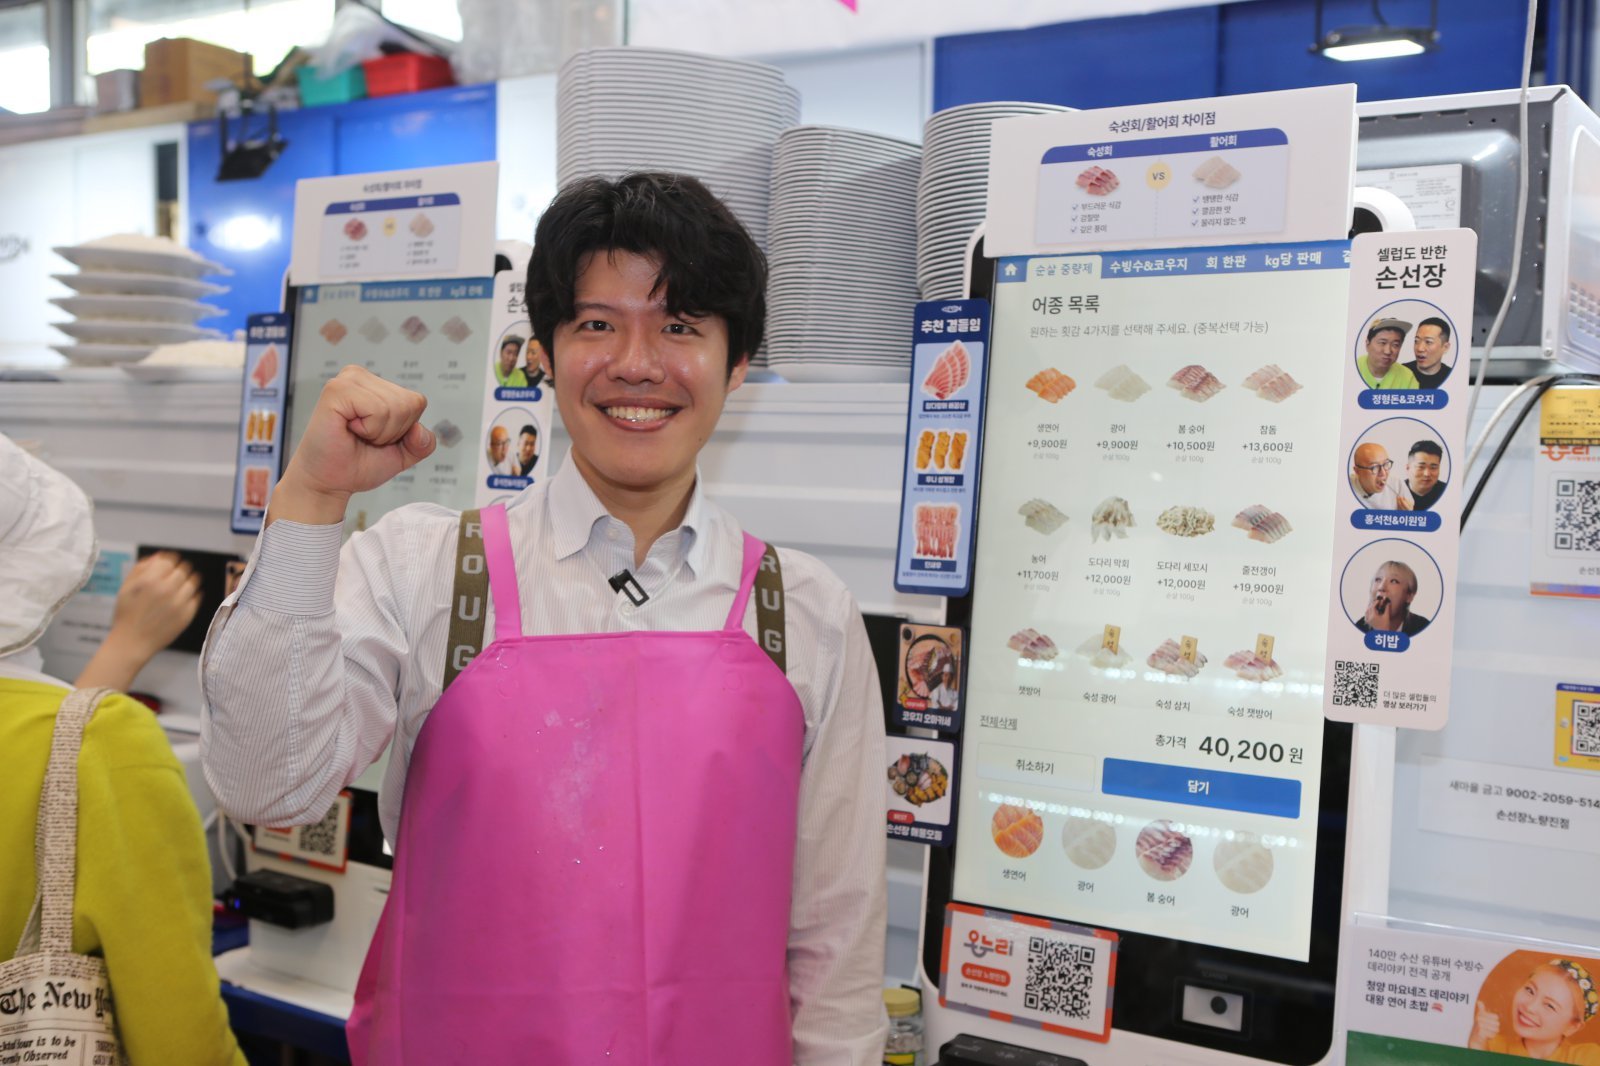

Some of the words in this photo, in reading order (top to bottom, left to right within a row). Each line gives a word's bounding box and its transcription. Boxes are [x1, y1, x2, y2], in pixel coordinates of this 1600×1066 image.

[1109, 115, 1179, 133] 숙성회/활어회
[1182, 112, 1216, 128] 차이점
[1209, 135, 1237, 147] 활어회
[1086, 145, 1113, 157] 숙성회
[1152, 172, 1165, 181] VS
[1265, 253, 1293, 268] kg당
[1297, 251, 1321, 265] 판매
[1377, 246, 1417, 262] 셀럽도
[1420, 245, 1447, 260] 반한
[1109, 257, 1188, 272] 수빙수&코우지
[1206, 256, 1218, 270] 회
[1222, 255, 1247, 269] 한판
[1375, 263, 1447, 290] 손선장
[1031, 296, 1063, 316] 어종
[1068, 294, 1100, 315] 목록
[921, 319, 944, 334] 추천
[1030, 325, 1058, 338] 원하는
[1083, 323, 1120, 338] 4가지를
[1122, 323, 1154, 336] 선택해
[1193, 321, 1240, 336] (중복선택
[1243, 320, 1269, 334] 가능)
[1372, 393, 1434, 405] 정형돈&코우지
[1110, 424, 1126, 434] 광어
[1188, 424, 1205, 435] 숭어
[1260, 425, 1276, 436] 참돔
[1027, 439, 1068, 450] +9,900원
[1096, 440, 1138, 451] +9,900원
[1166, 441, 1215, 452] +10,500원
[1242, 442, 1293, 453] +13,600원
[1364, 513, 1427, 527] 홍석천&이원일
[1088, 557, 1112, 568] 도다리
[1157, 561, 1181, 572] 도다리
[1017, 570, 1059, 582] +11,700원
[1085, 574, 1131, 586] +12,000원
[1157, 579, 1206, 590] +12,000원
[1233, 582, 1284, 595] +19,900원
[1374, 633, 1400, 649] 히밥
[1083, 692, 1097, 702] 숙성
[1099, 693, 1117, 704] 광어
[1155, 699, 1170, 710] 숙성
[1172, 700, 1191, 711] 삼치
[1227, 706, 1244, 717] 숙성
[1398, 701, 1427, 712] 보러가기
[979, 715, 1018, 731] 전체삭제
[1154, 734, 1187, 749] 총가격
[1015, 759, 1055, 774] 취소하기
[1187, 780, 1210, 795] 담기
[1002, 868, 1027, 882] 생연어
[1077, 880, 1095, 893] 광어
[1157, 893, 1176, 907] 숭어
[1230, 905, 1250, 918] 광어
[1369, 948, 1396, 962] 140만
[1400, 952, 1418, 965] 수산
[1422, 954, 1451, 969] 유튜버
[1454, 959, 1485, 973] 수빙수
[1367, 961, 1406, 976] 데리야키
[1409, 966, 1428, 979] 전격
[1431, 969, 1451, 982] 공개
[42, 982, 91, 1011] New
[1366, 980, 1385, 993] 청양
[1388, 984, 1427, 998] 마요네즈
[1430, 989, 1470, 1005] 데리야키
[1365, 994, 1384, 1006] 대왕
[1387, 997, 1407, 1009] 연어
[1409, 1000, 1429, 1013] 초밥
